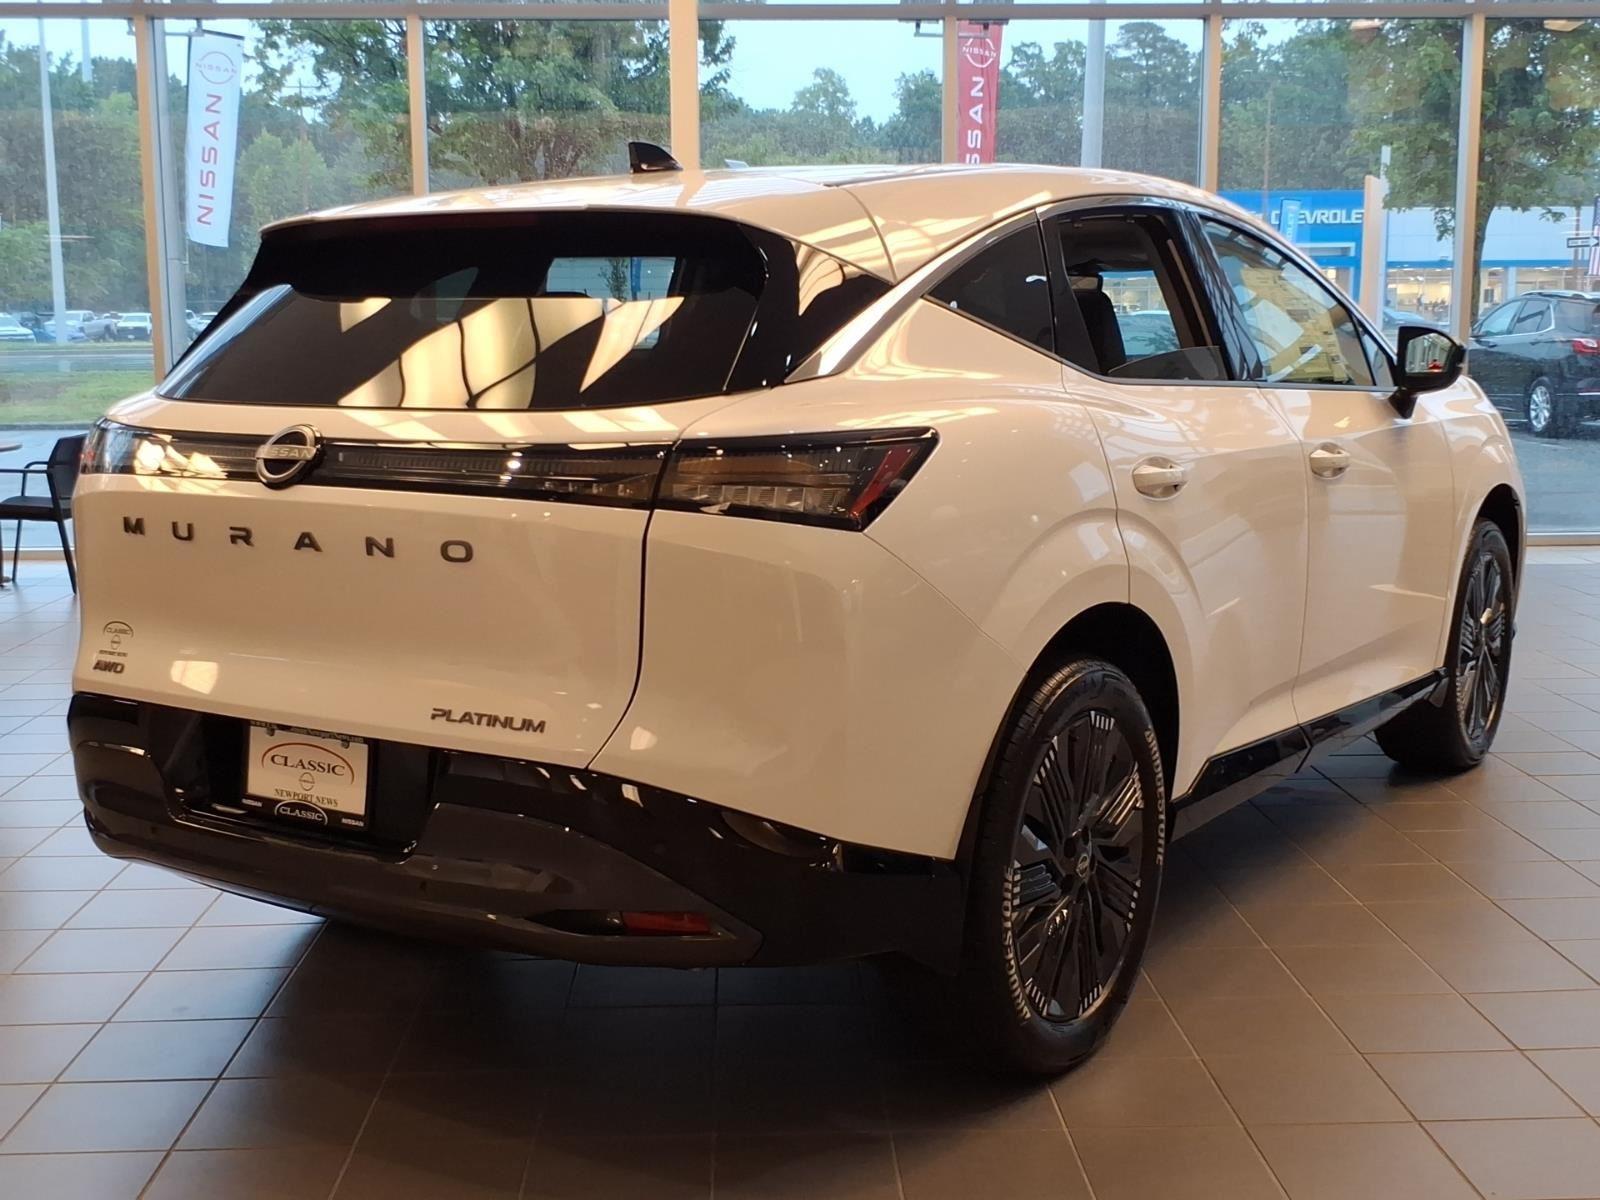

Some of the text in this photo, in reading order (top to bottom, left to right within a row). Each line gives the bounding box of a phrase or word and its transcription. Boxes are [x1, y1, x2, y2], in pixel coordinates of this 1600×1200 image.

[961, 45, 997, 58] NISSAN
[195, 62, 237, 74] NISSAN
[966, 76, 985, 164] SSAN
[197, 93, 223, 226] NISSAN
[1270, 208, 1364, 225] CEVROLE
[122, 515, 475, 564] MURANO
[93, 659, 125, 674] AWD
[430, 707, 547, 734] PLATINUM
[270, 754, 345, 776] CLASSIC
[273, 787, 339, 808] NEWPORT NEWS
[279, 806, 323, 821] CLASSIC
